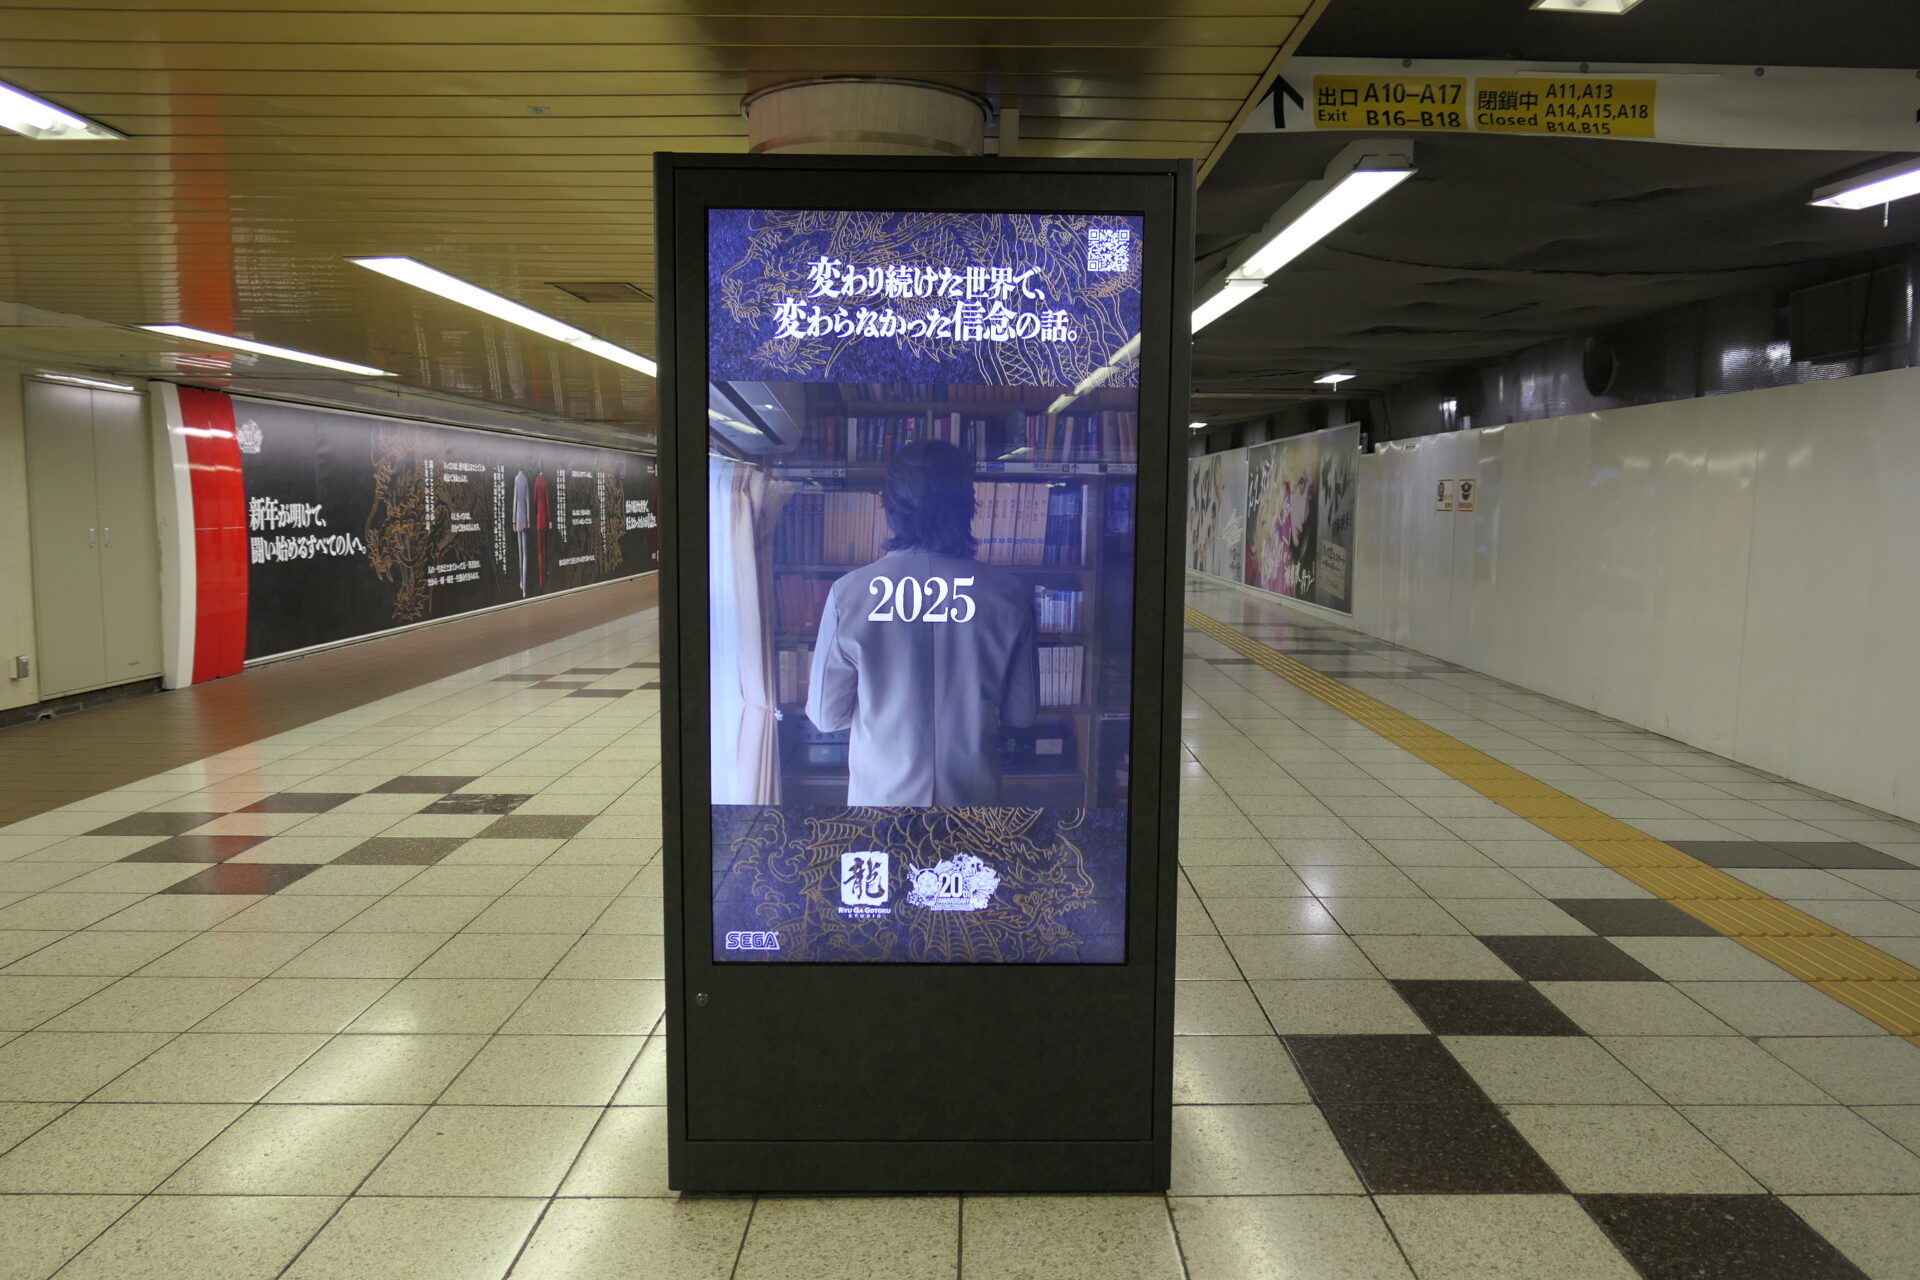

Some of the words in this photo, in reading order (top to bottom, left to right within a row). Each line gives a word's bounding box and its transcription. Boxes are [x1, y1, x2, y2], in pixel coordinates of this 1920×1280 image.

[1318, 87, 1358, 107] 出口
[1478, 90, 1538, 111] 閉鎖中
[1318, 109, 1348, 122] Exit
[1478, 113, 1538, 126] Closed
[806, 255, 1047, 301] 変わり続けた世界で、
[772, 297, 1078, 343] 変わらなかった信念の話。
[248, 496, 327, 532] 新年が明けて、
[867, 574, 977, 623] 2025
[843, 856, 885, 900] 龍
[725, 931, 780, 950] SEGA
